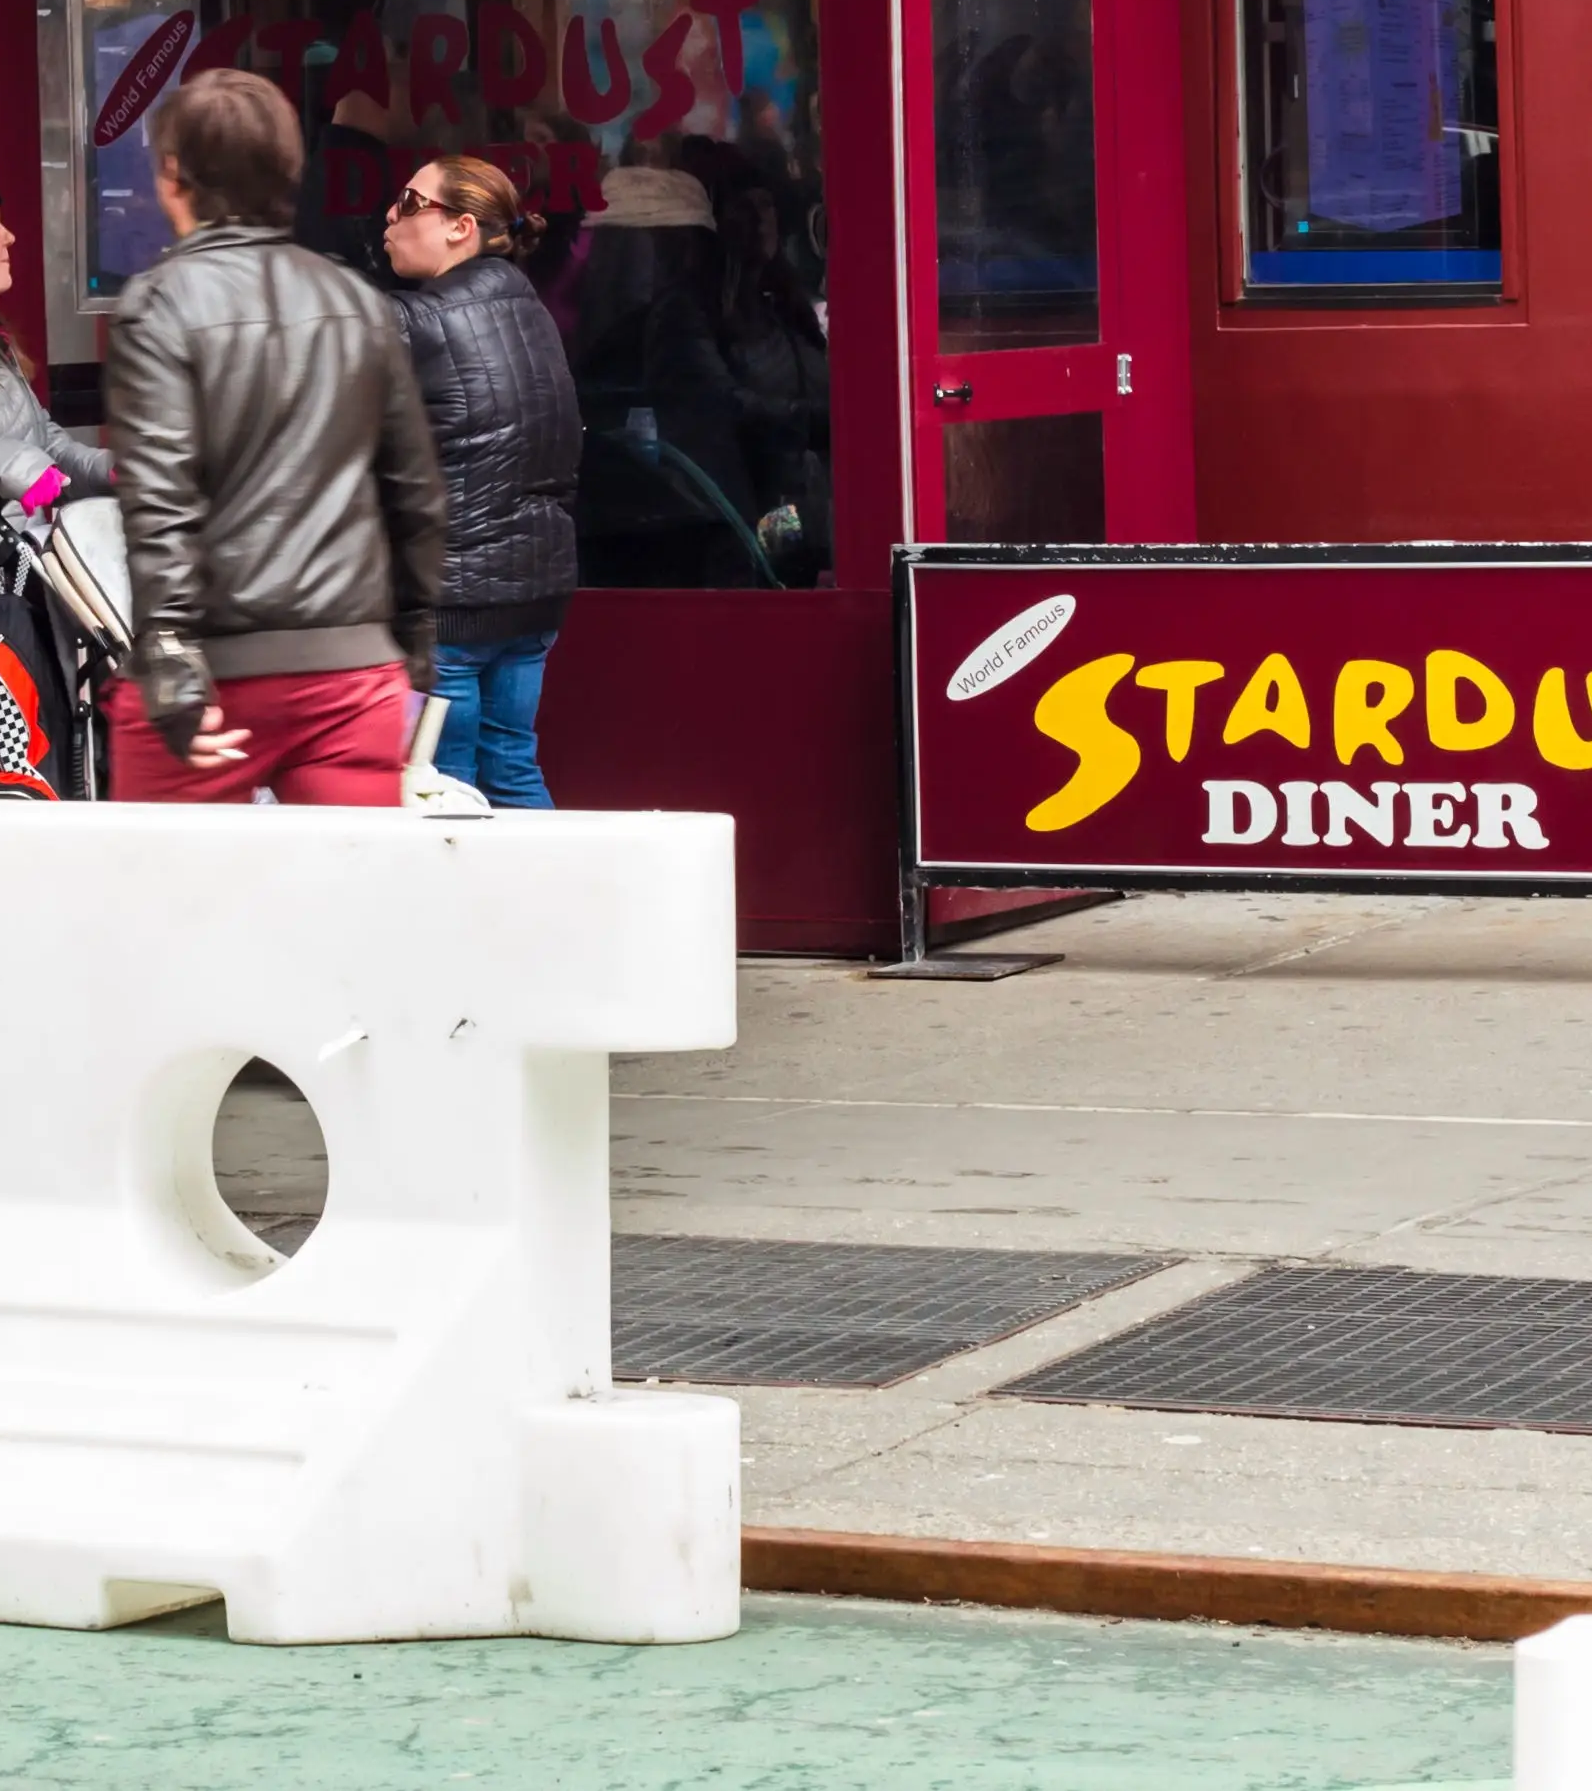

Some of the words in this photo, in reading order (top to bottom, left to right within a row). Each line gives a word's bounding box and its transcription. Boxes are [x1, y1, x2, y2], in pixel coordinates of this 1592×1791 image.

[100, 84, 140, 138] World
[136, 20, 187, 89] Famous
[956, 651, 1004, 694] World
[1003, 603, 1066, 658] Famous
[1200, 779, 1551, 851] DINER
